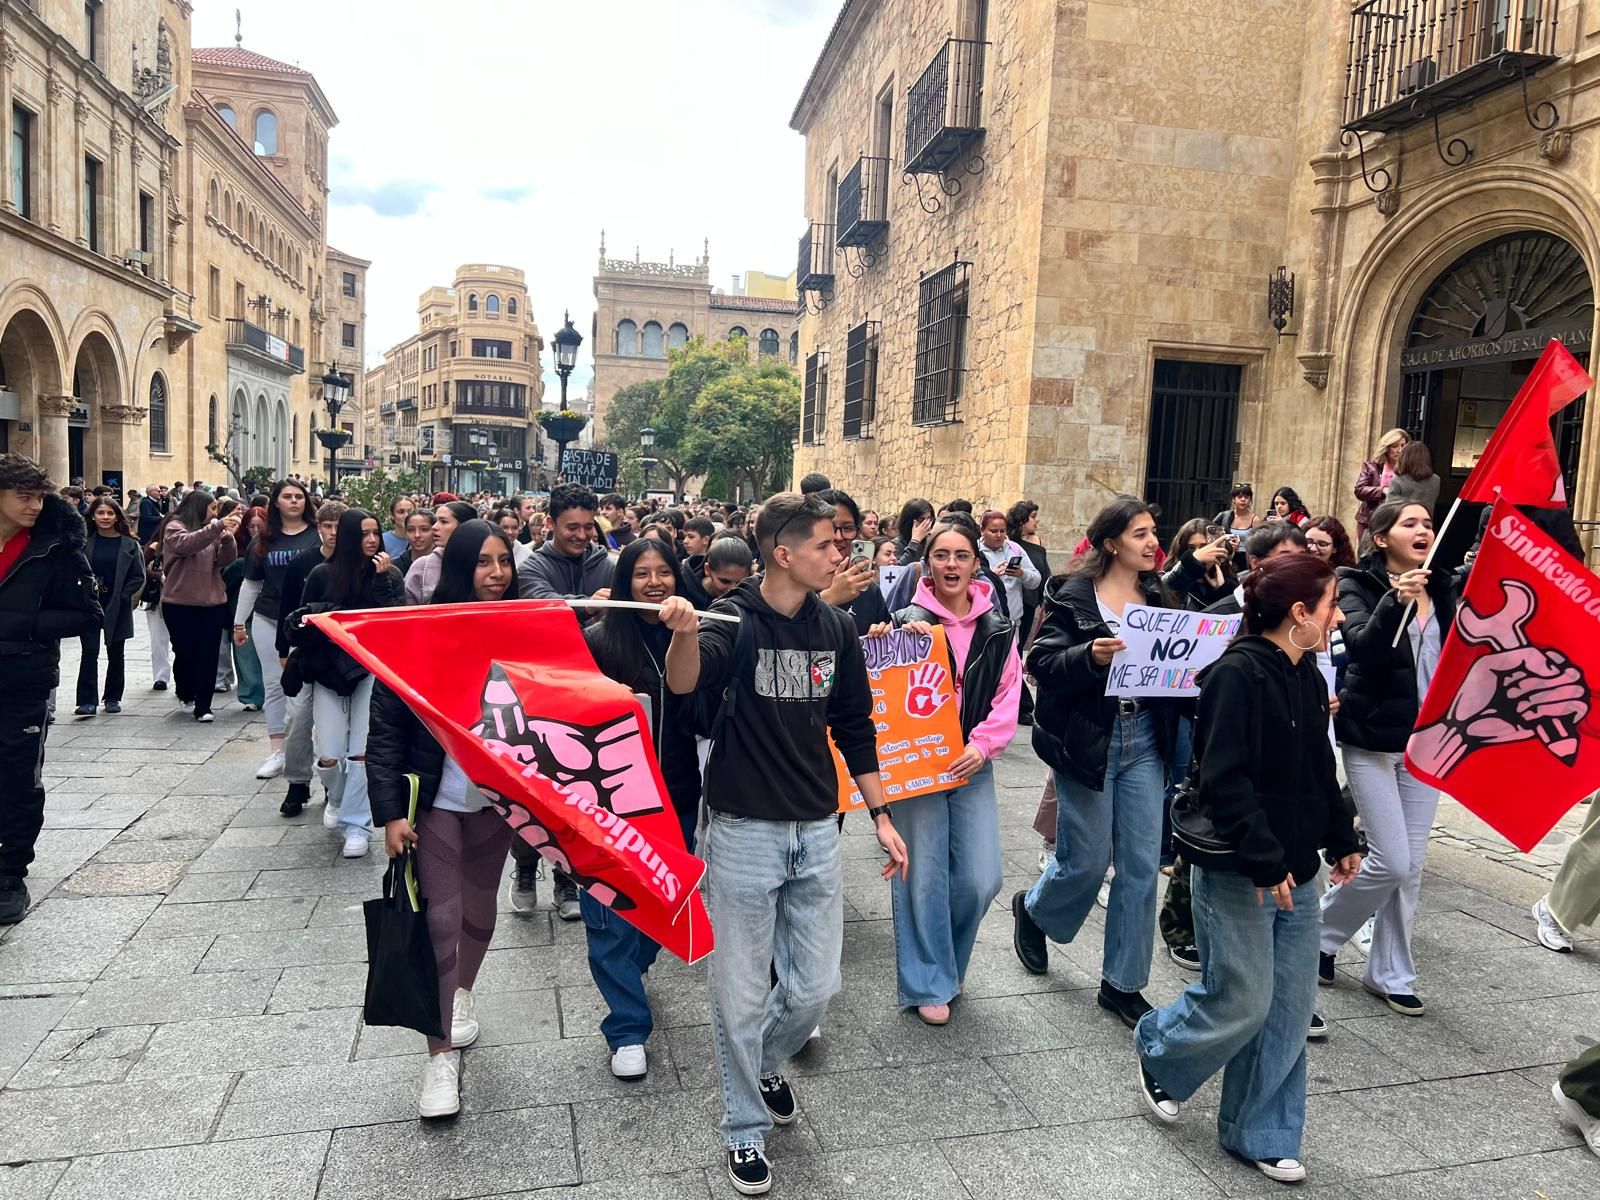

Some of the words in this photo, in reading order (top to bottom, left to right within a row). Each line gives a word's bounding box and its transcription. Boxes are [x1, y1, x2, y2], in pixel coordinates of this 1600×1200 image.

[1401, 353, 1429, 367] CAJA
[1431, 350, 1445, 364] DE
[1447, 341, 1501, 361] AHORROS
[1504, 338, 1519, 354] DE
[561, 462, 597, 477] MIRAR
[599, 465, 606, 477] A
[563, 450, 595, 464] BASTA
[596, 453, 610, 466] DE
[585, 475, 613, 489] LADO
[1490, 515, 1592, 603] Sindicato
[1126, 609, 1172, 633] QUE
[1169, 613, 1190, 635] LO
[1150, 636, 1199, 662] NO!
[1109, 664, 1137, 690] ME
[1135, 665, 1159, 687] SEA
[886, 785, 901, 794] POR
[905, 778, 933, 790] SANDRA
